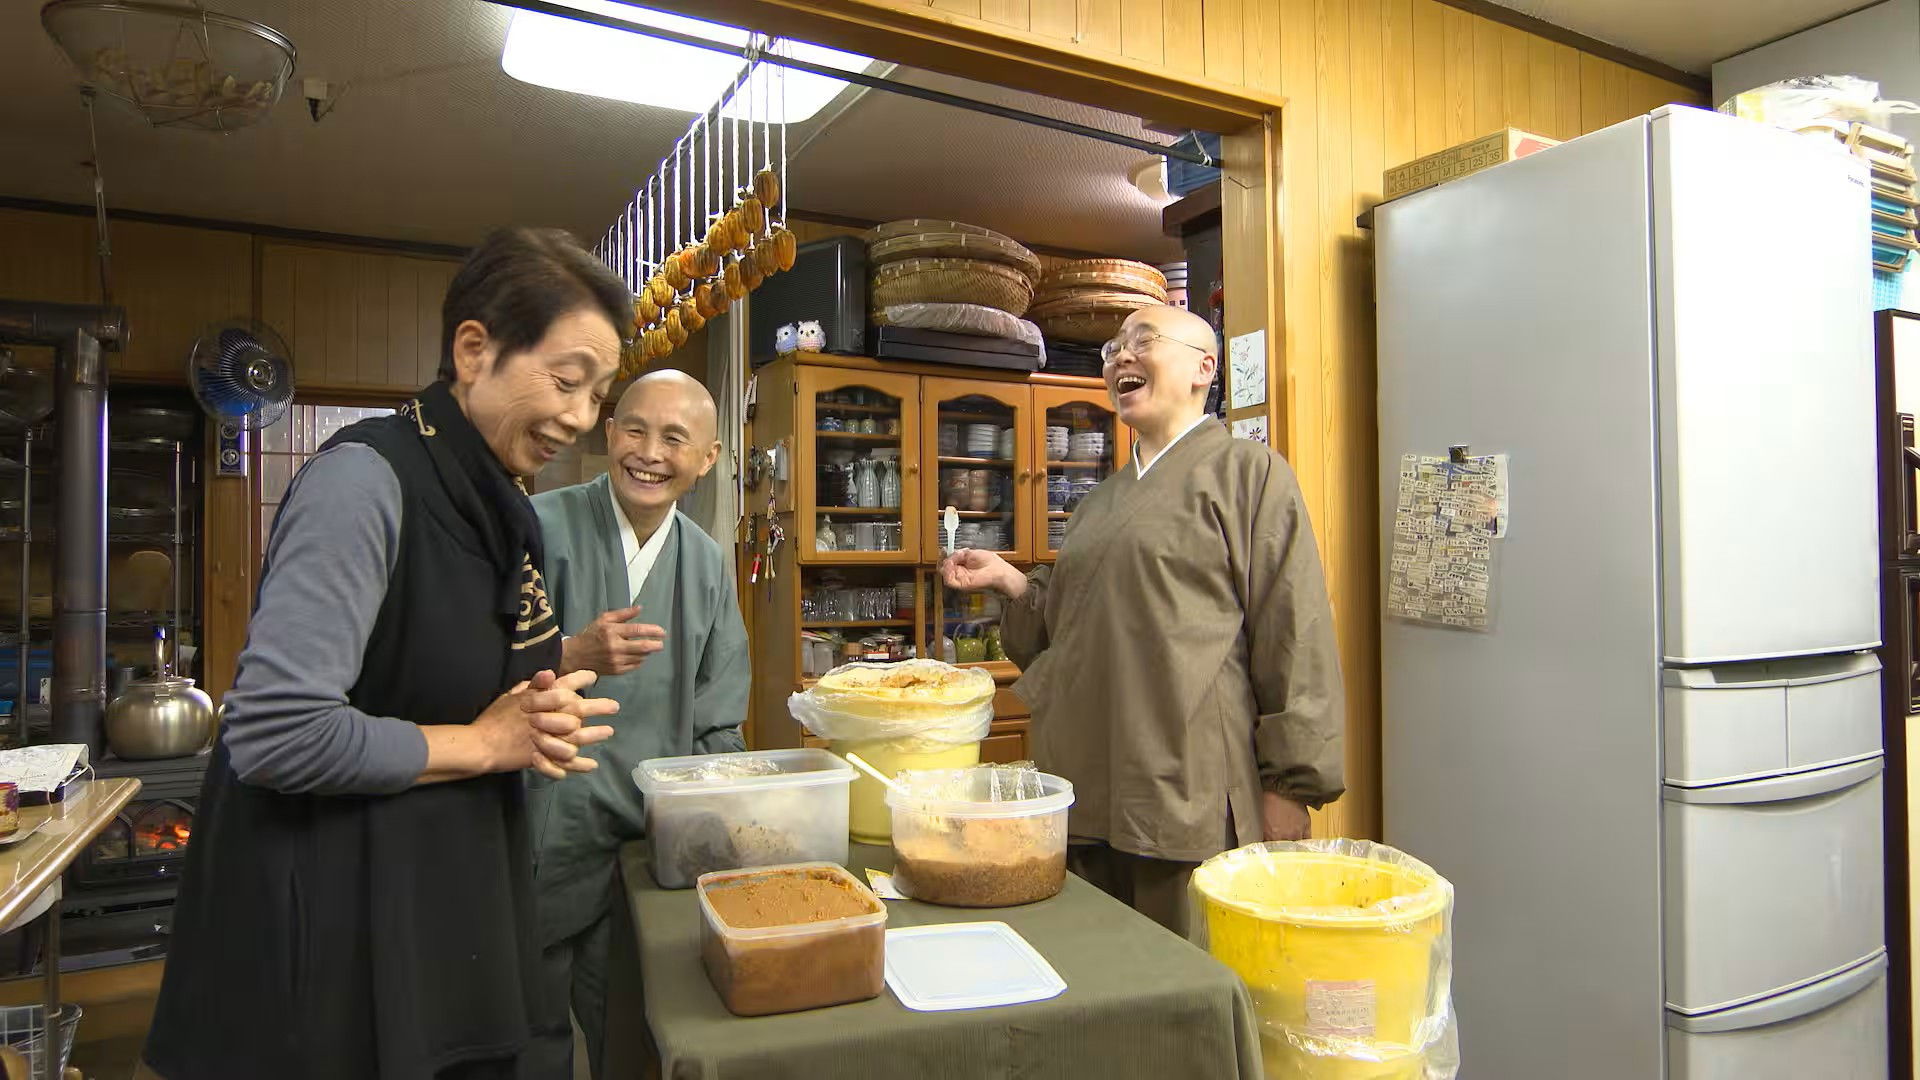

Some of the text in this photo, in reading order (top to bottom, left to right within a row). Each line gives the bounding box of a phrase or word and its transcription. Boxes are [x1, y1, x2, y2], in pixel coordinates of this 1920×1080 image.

[1443, 167, 1451, 177] M
[1473, 157, 1484, 167] 2S
[1489, 151, 1500, 161] 3S
